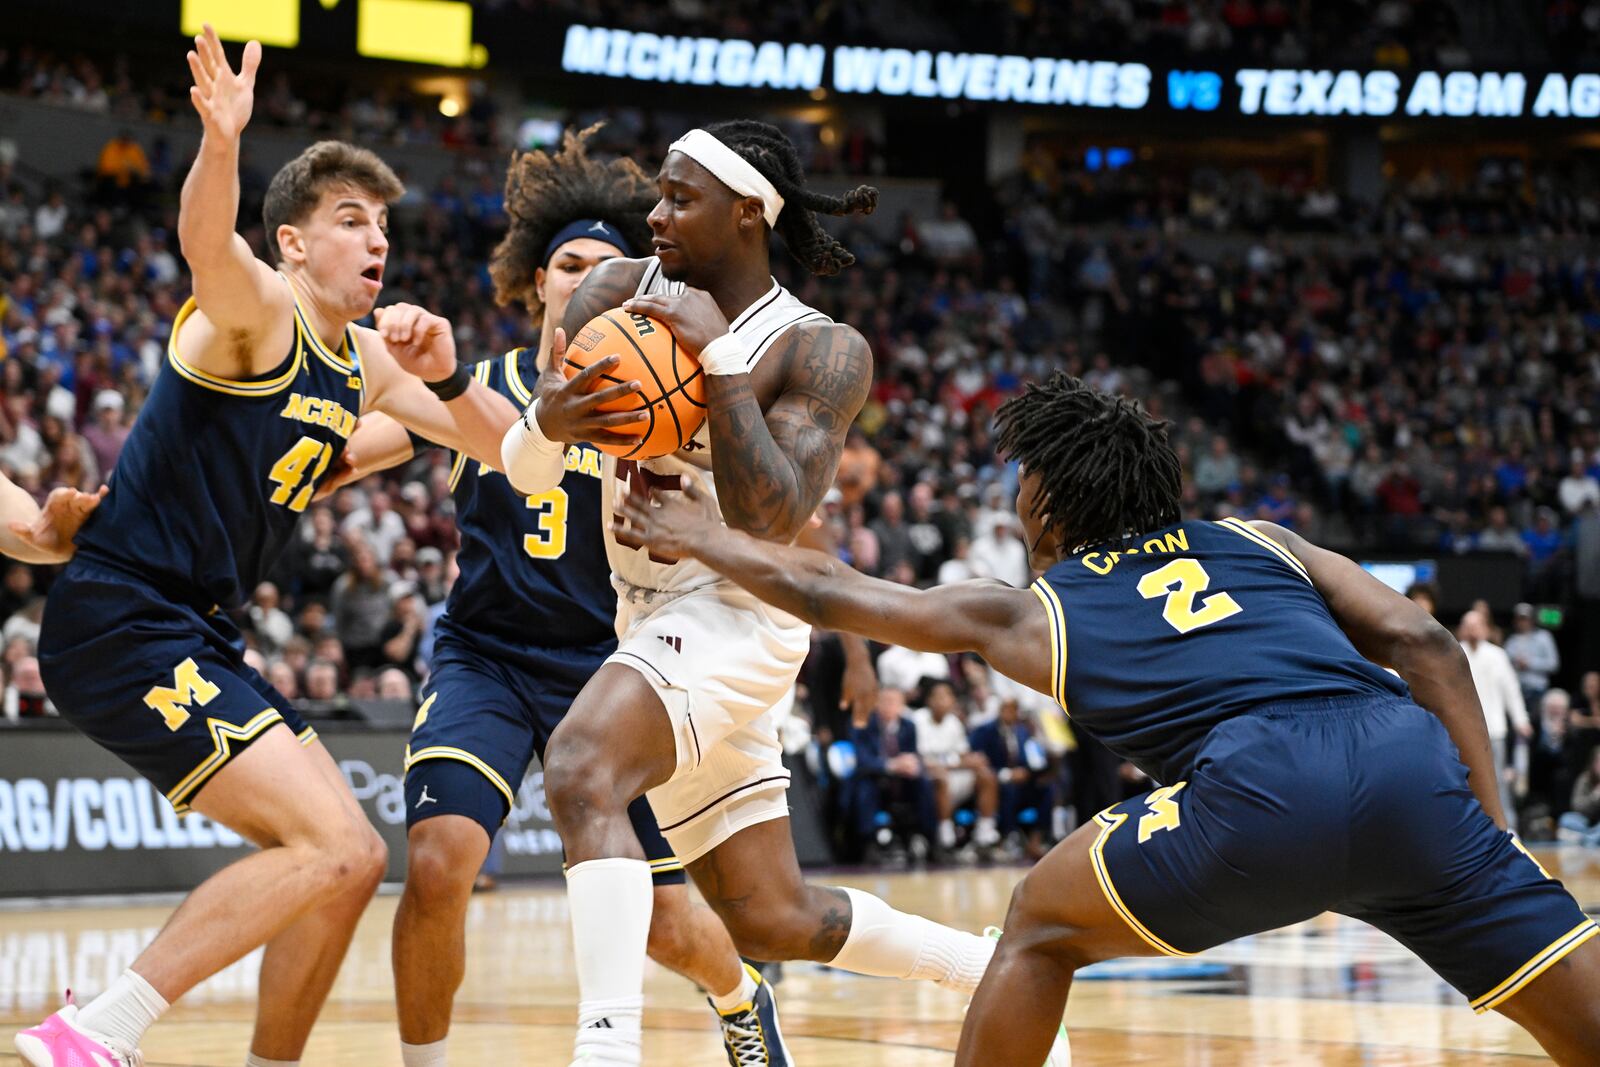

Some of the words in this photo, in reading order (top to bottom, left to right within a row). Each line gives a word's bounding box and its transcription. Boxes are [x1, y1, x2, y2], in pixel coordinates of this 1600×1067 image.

[562, 24, 826, 90] MICHIGAN
[833, 46, 1152, 108] WOLVERINES
[1235, 69, 1400, 116] TEXAS
[523, 486, 569, 560] 3
[1136, 558, 1244, 634] 2
[142, 656, 221, 732] M
